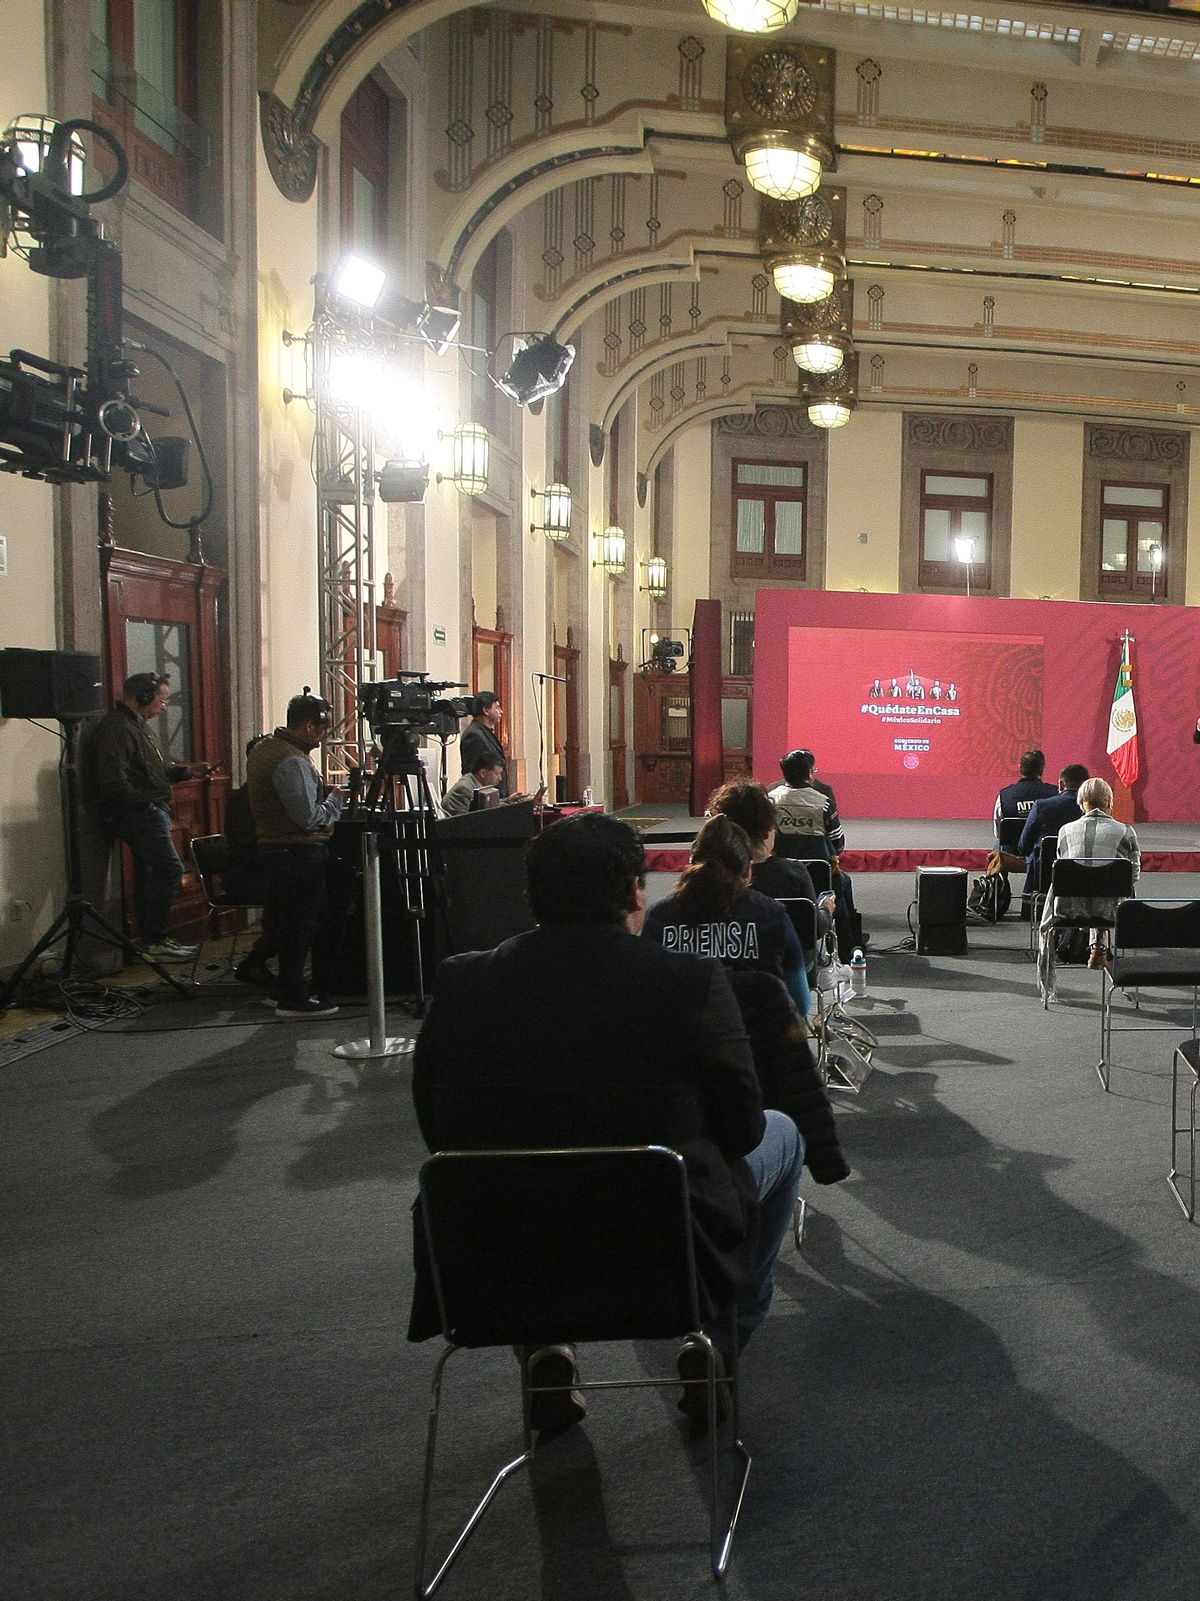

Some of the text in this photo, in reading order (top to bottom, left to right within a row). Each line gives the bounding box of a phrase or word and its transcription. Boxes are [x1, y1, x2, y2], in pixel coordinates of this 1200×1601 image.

[861, 703, 960, 716] #QuédateEnCasa
[881, 716, 941, 724] #MéxicoSolidario
[893, 743, 930, 751] MÉXICO
[662, 921, 759, 959] PRENSA
